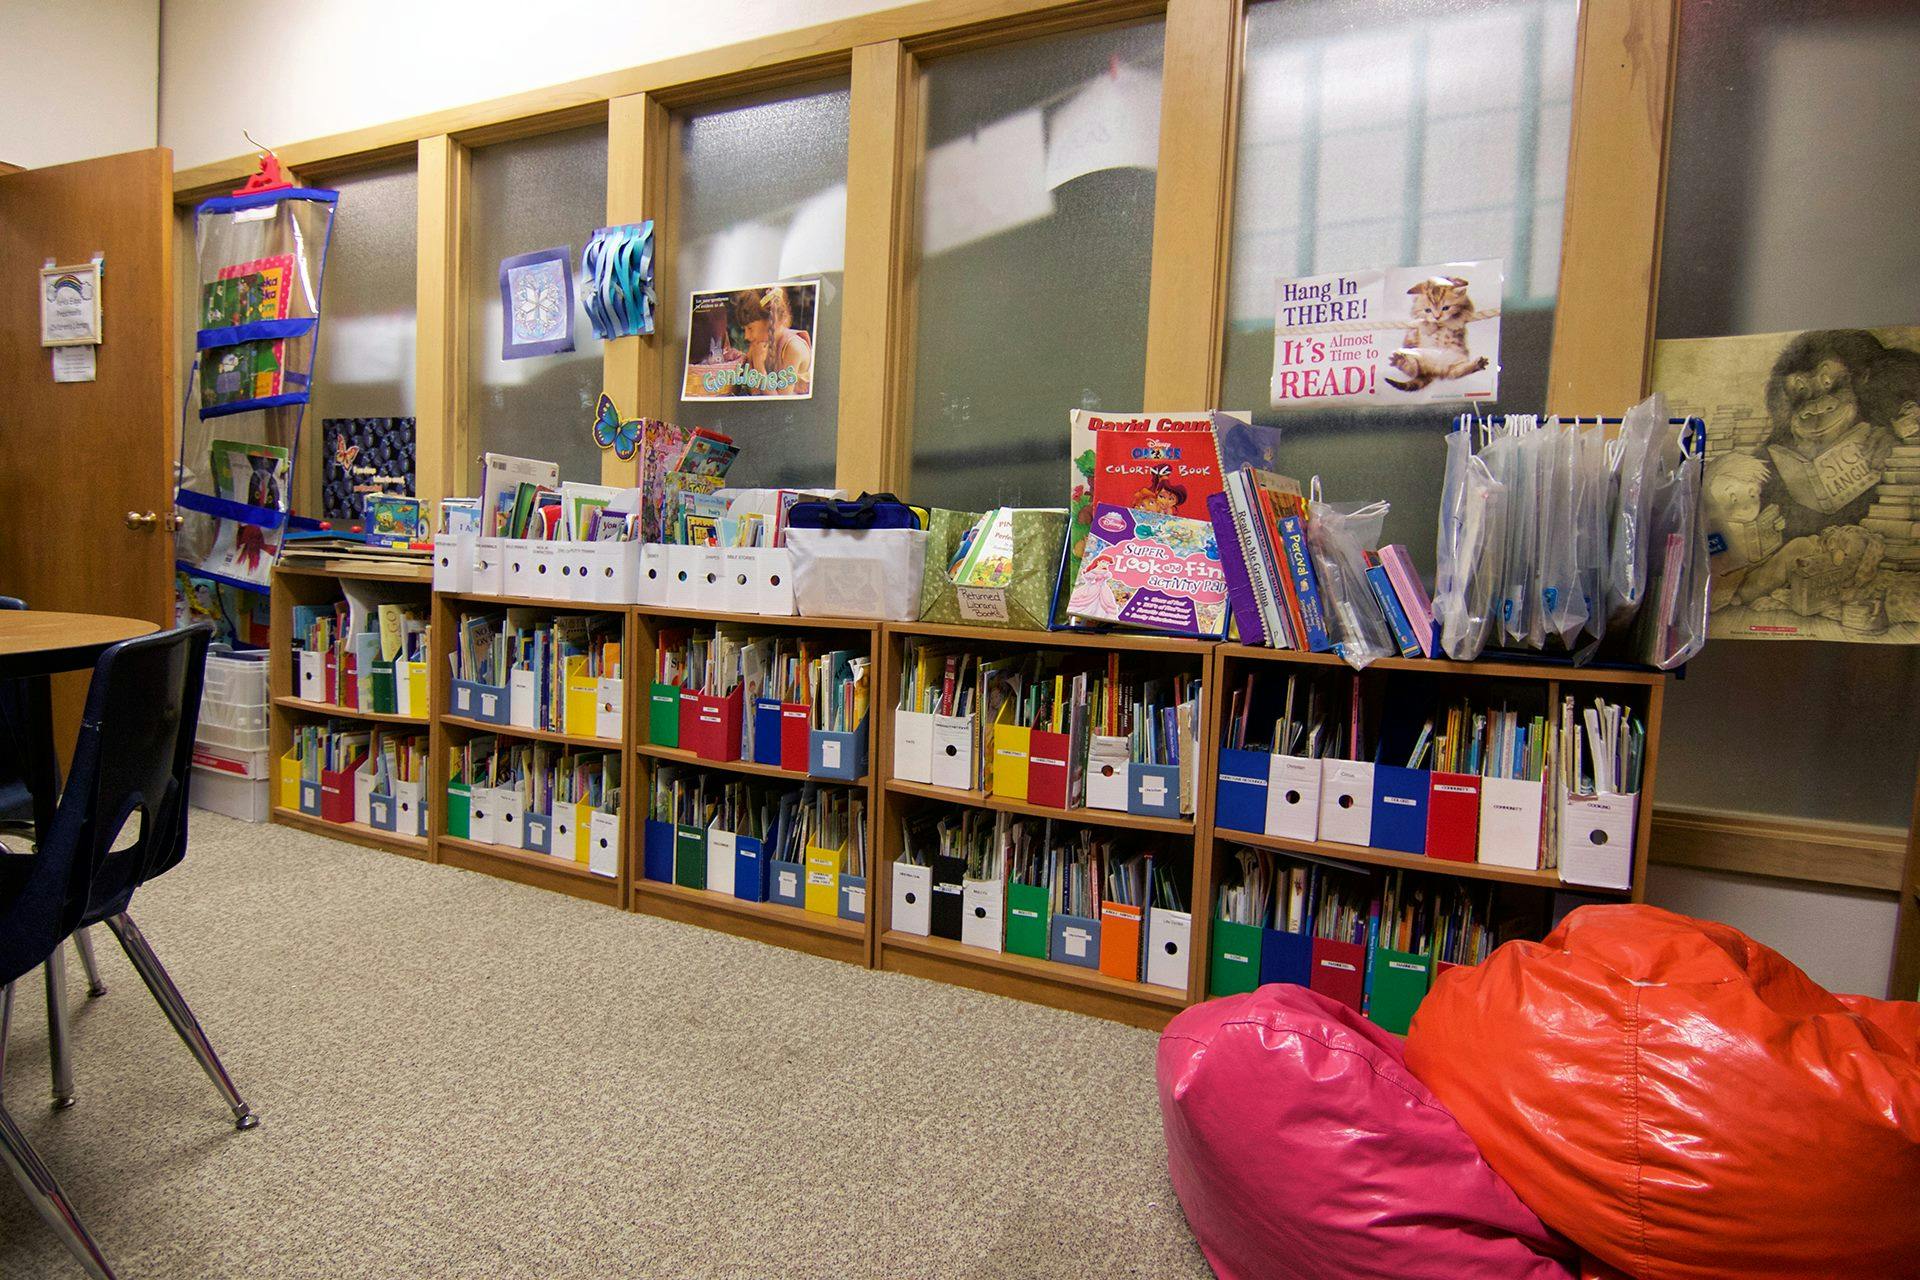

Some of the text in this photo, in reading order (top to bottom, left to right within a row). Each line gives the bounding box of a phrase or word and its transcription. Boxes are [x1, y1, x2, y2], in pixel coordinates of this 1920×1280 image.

[1284, 278, 1357, 302] Hang In
[1284, 299, 1367, 326] THERE!
[1283, 337, 1325, 365] It's
[1330, 334, 1372, 348] Almost
[1330, 348, 1378, 361] Time to
[703, 363, 797, 392] Gentleness
[1280, 365, 1376, 398] READ!
[1088, 417, 1211, 431] David Coun
[1146, 438, 1171, 449] Disney
[1105, 465, 1210, 476] COLORING BOOK
[1821, 444, 1860, 479] SIG
[1826, 463, 1869, 497] LANGU
[1114, 555, 1162, 574] Look
[1185, 562, 1225, 578] Fin
[1238, 511, 1269, 607] Read to Me Grandma
[1290, 534, 1309, 576] Percival
[959, 589, 1001, 601] Returned
[966, 600, 997, 610] Library
[972, 609, 1004, 618] Books
